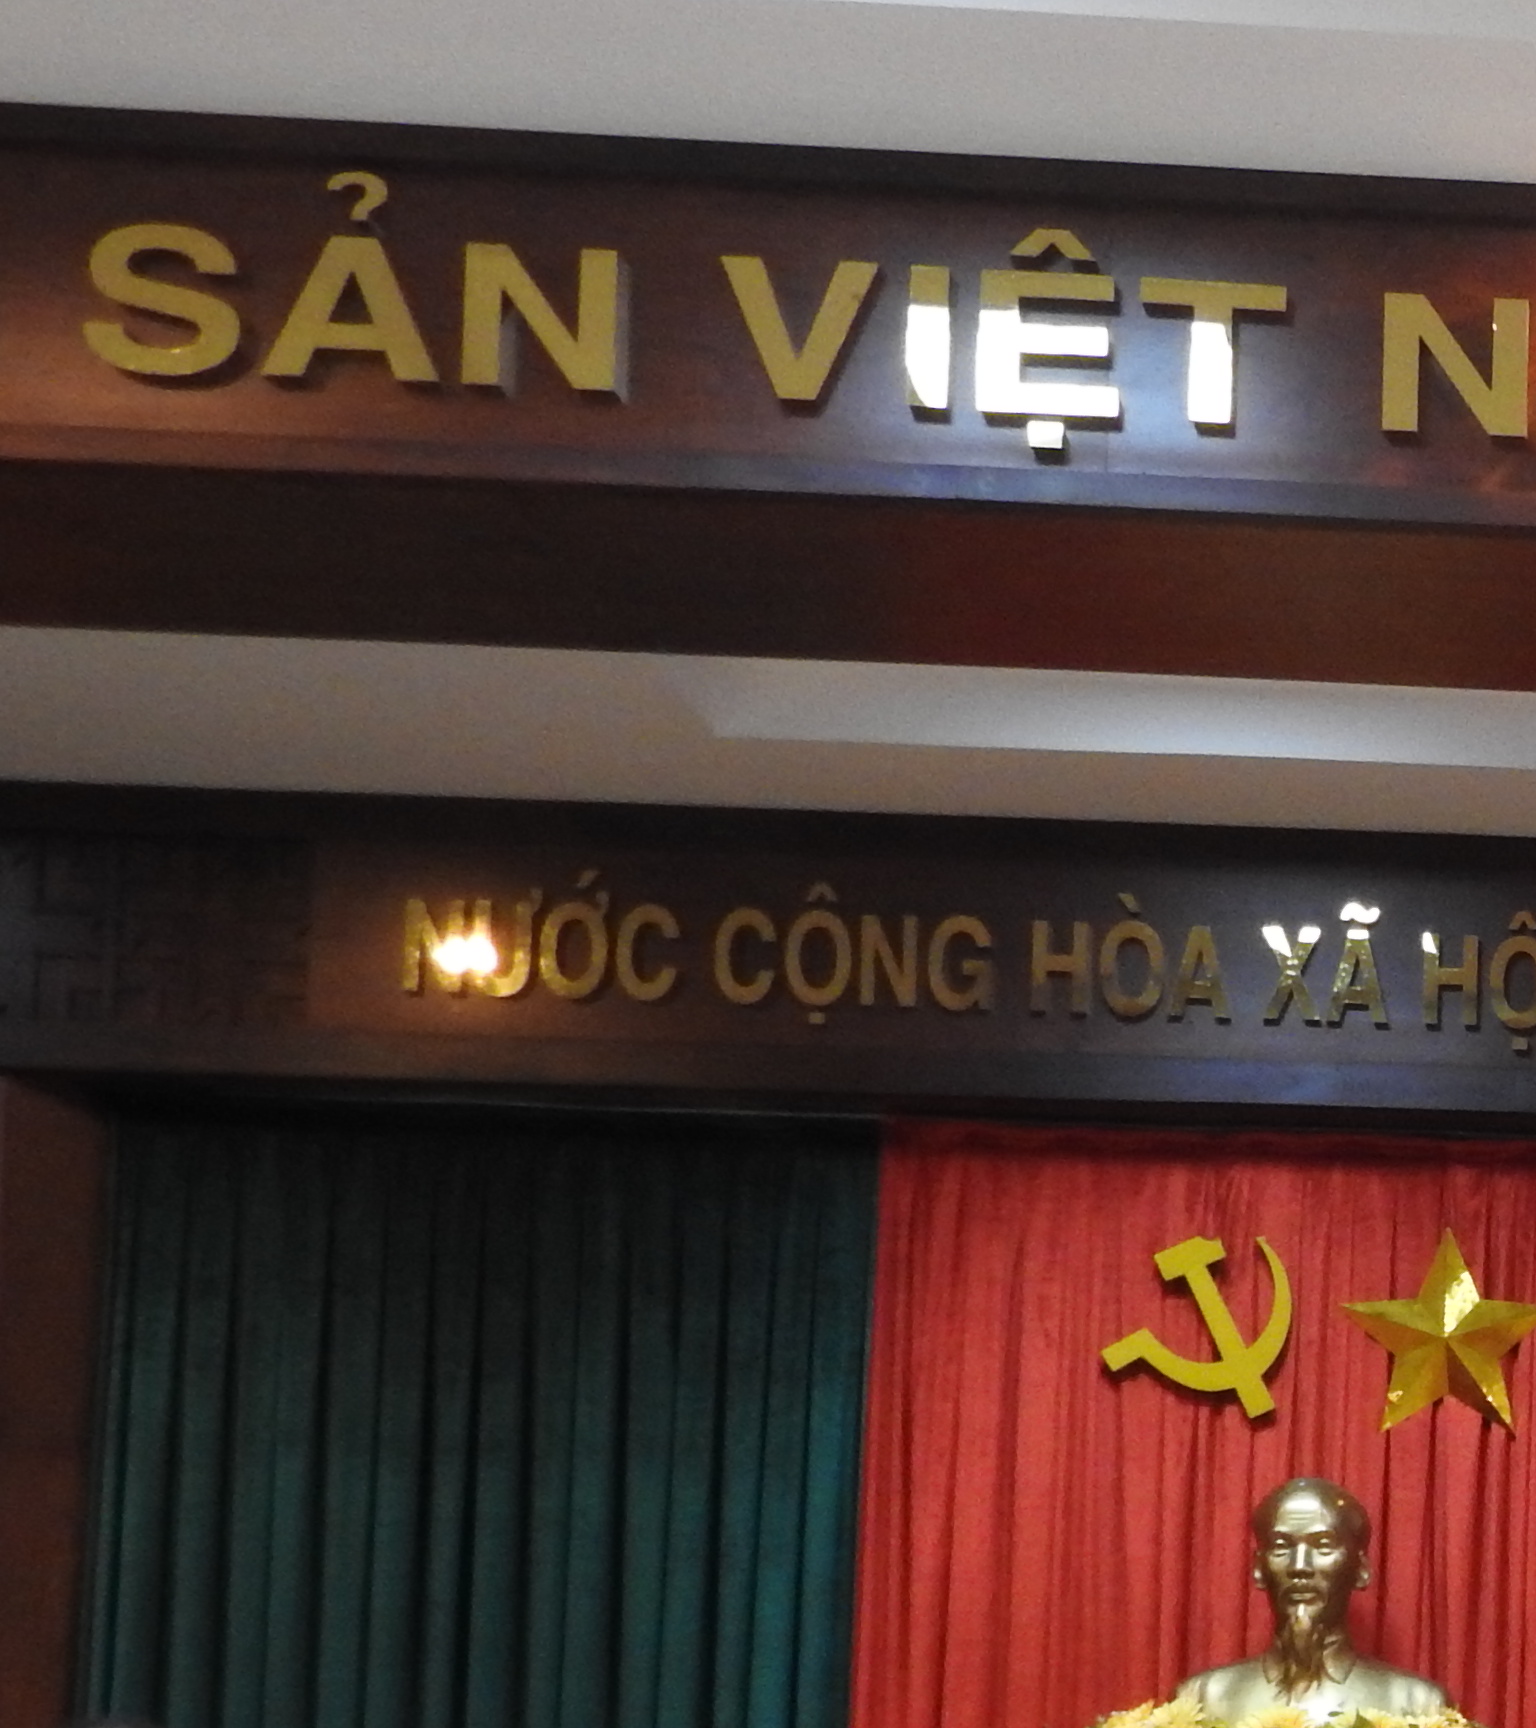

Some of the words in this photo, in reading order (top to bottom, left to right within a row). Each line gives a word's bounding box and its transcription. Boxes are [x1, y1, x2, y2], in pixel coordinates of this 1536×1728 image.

[82, 171, 625, 400] SẢN
[721, 229, 1288, 450] VIỆT
[403, 870, 678, 999] NƯỚC
[714, 884, 992, 1025] CỘNG
[1031, 894, 1231, 1023] HÒA
[1262, 902, 1391, 1031] XÃ
